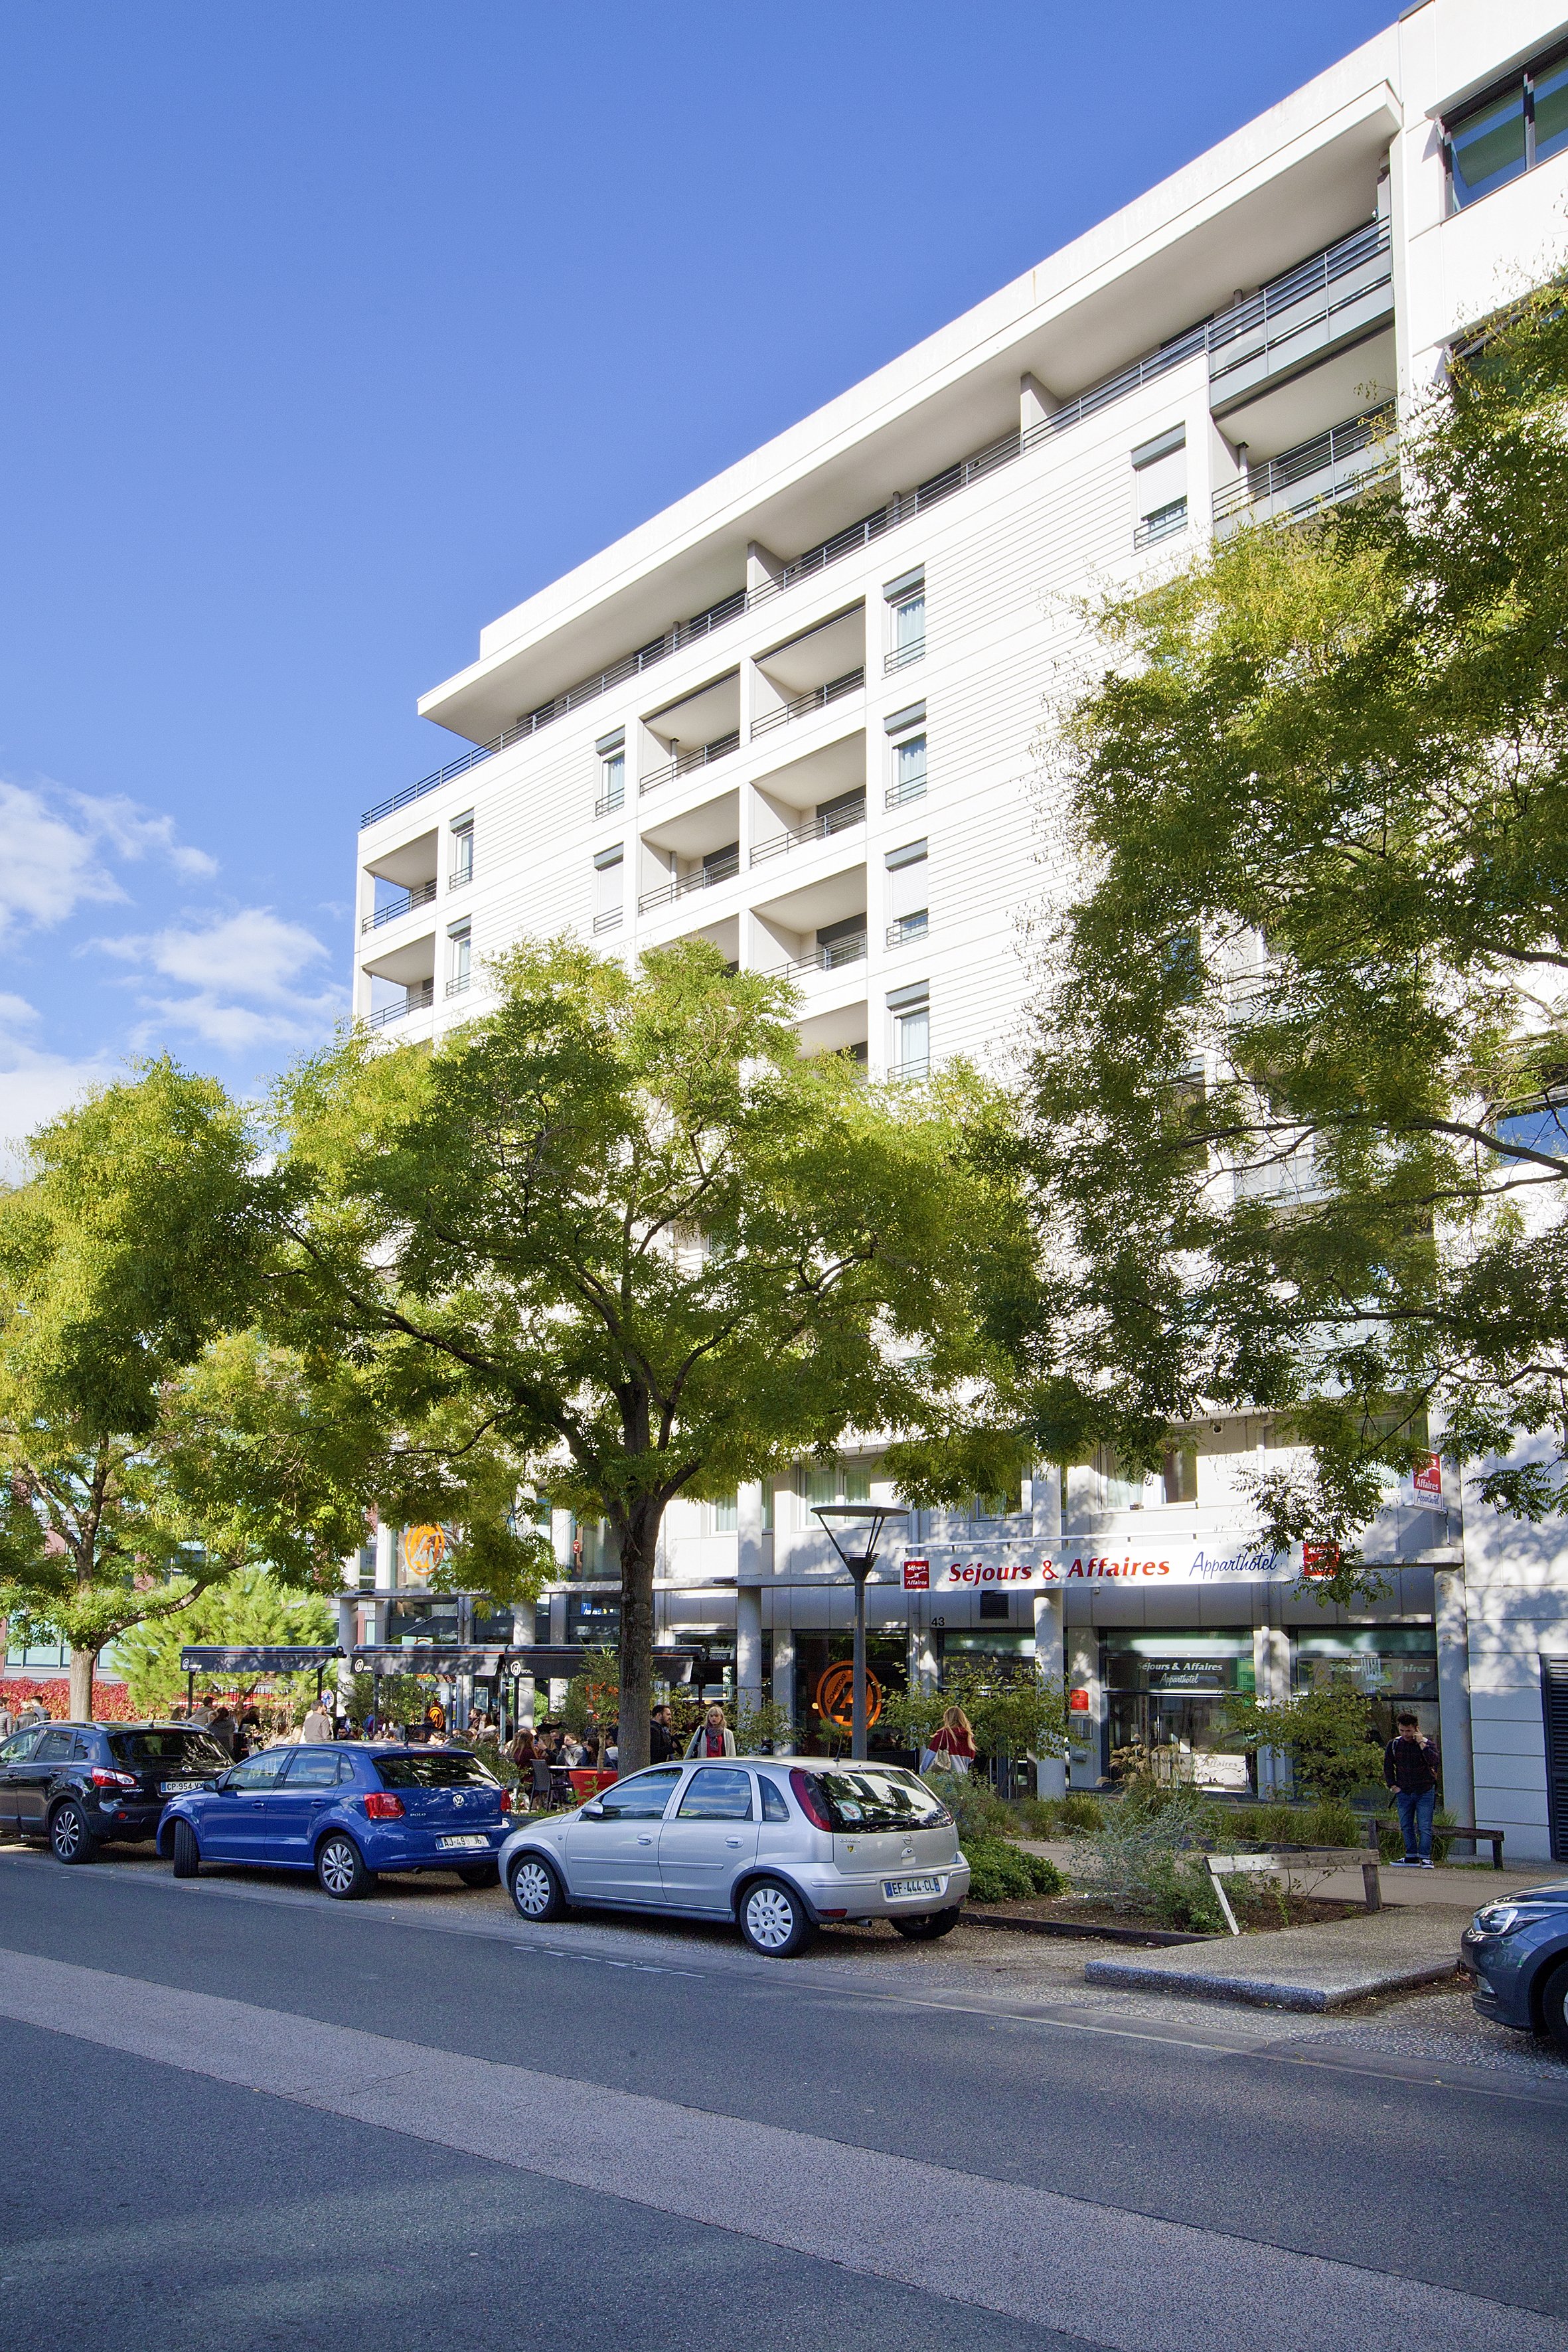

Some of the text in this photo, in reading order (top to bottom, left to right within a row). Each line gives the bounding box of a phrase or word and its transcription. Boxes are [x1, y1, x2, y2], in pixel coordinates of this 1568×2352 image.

[1416, 1478, 1439, 1490] Affaires
[949, 1562, 1032, 1586] Séjours
[1042, 1560, 1059, 1580] &
[1067, 1557, 1170, 1578] Affaires
[931, 1616, 945, 1626] 43
[1137, 1662, 1223, 1672] Séjours & Affaires
[826, 1673, 847, 1704] COMPTOIR
[892, 1879, 935, 1895] EF-444-CL
